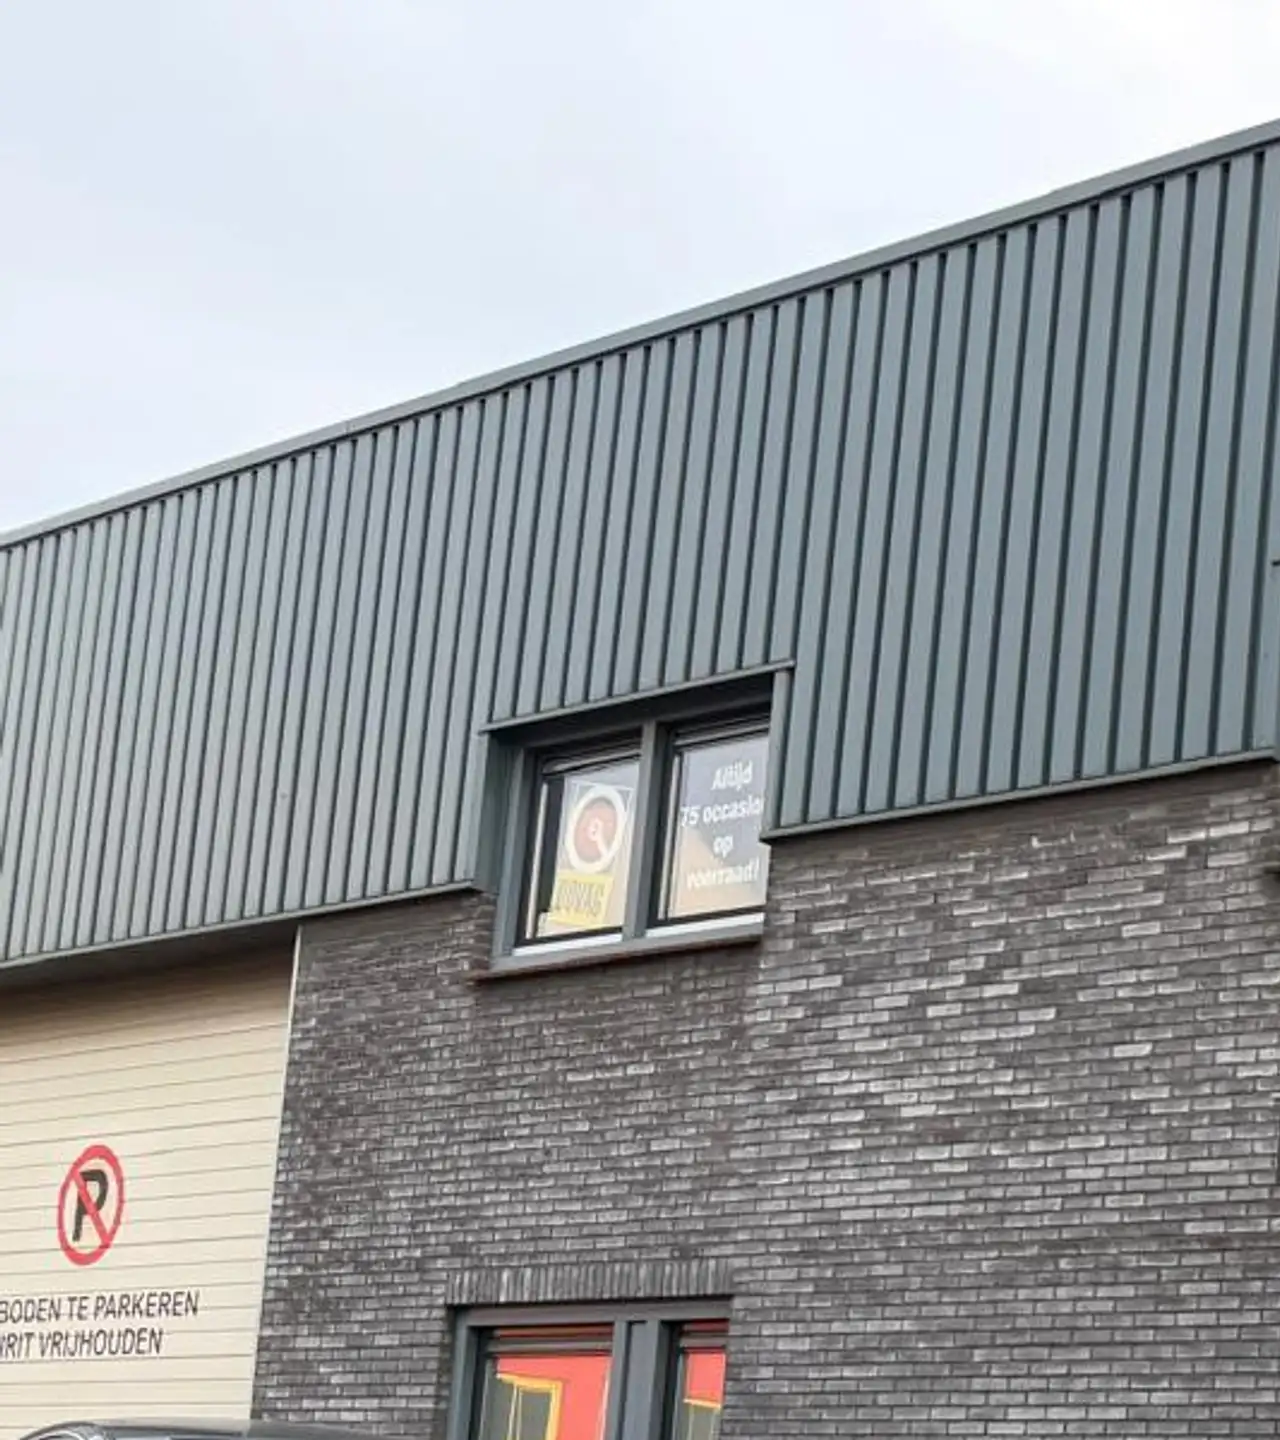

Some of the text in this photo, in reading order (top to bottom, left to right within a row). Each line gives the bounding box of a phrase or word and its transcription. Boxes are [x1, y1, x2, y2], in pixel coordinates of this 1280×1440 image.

[680, 805, 700, 828] 75
[67, 1295, 91, 1321] TE
[94, 1289, 201, 1321] PARKEREN
[39, 1326, 165, 1358] VRIJHOUDEN
